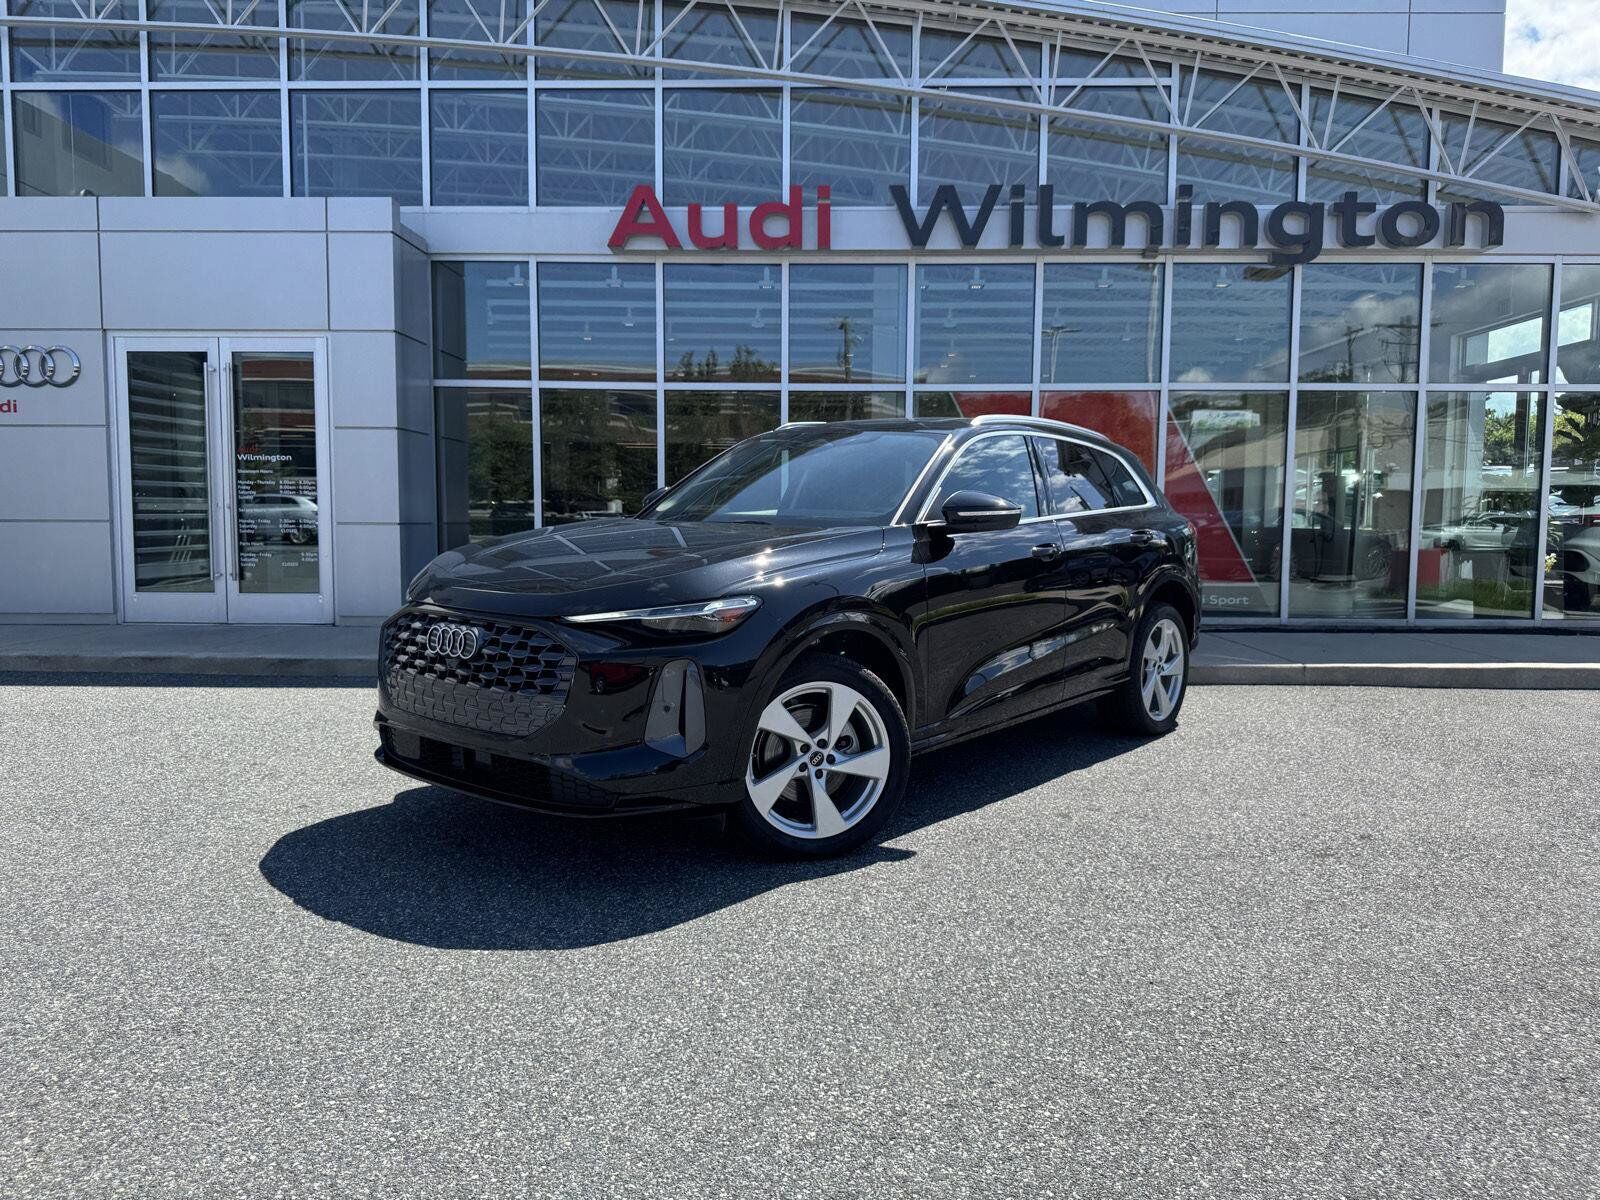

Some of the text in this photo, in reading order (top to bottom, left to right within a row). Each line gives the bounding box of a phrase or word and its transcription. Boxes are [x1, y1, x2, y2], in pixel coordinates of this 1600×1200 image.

[607, 184, 1505, 264] Audi Wilmington
[237, 454, 292, 462] Wilmington
[1209, 595, 1249, 606] Sport
